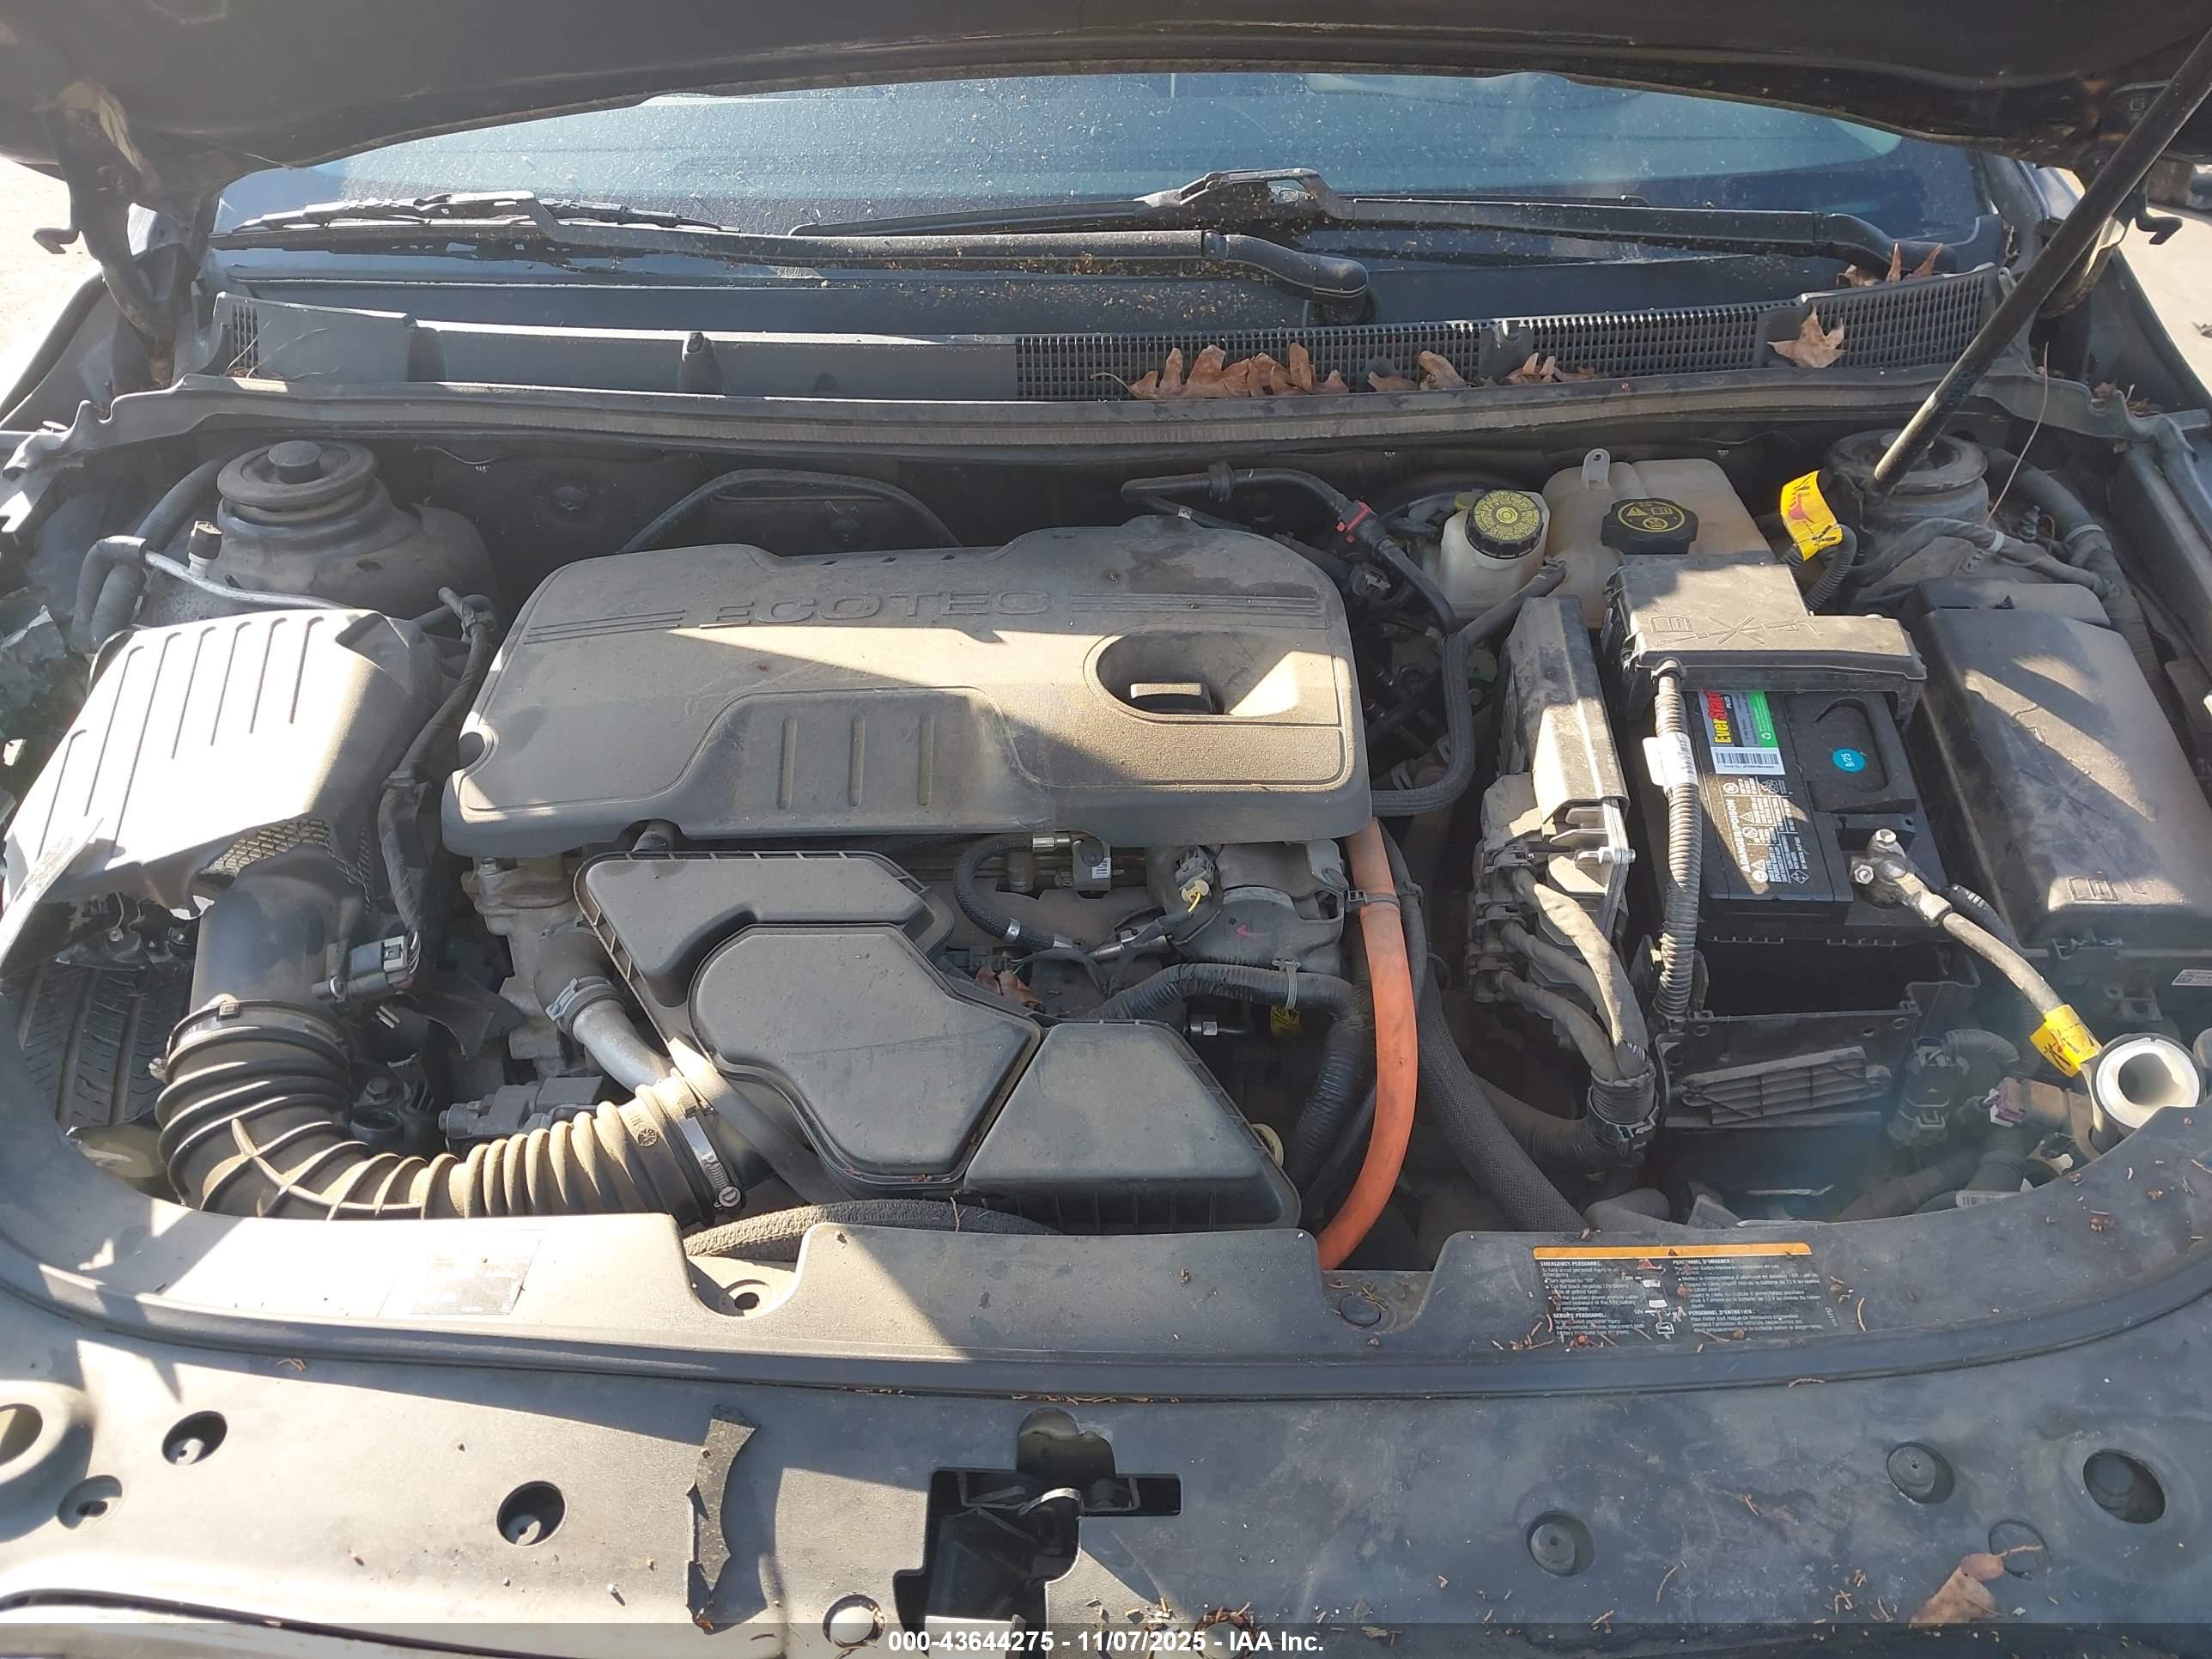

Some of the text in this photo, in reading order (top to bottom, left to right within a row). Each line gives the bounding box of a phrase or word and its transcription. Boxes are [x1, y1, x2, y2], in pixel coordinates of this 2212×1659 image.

[716, 590, 1051, 624] ECOTEC
[1723, 695, 1732, 708] PLUS
[1841, 753, 1855, 767] 9/25
[1725, 799, 1750, 865] DANGER/POISON
